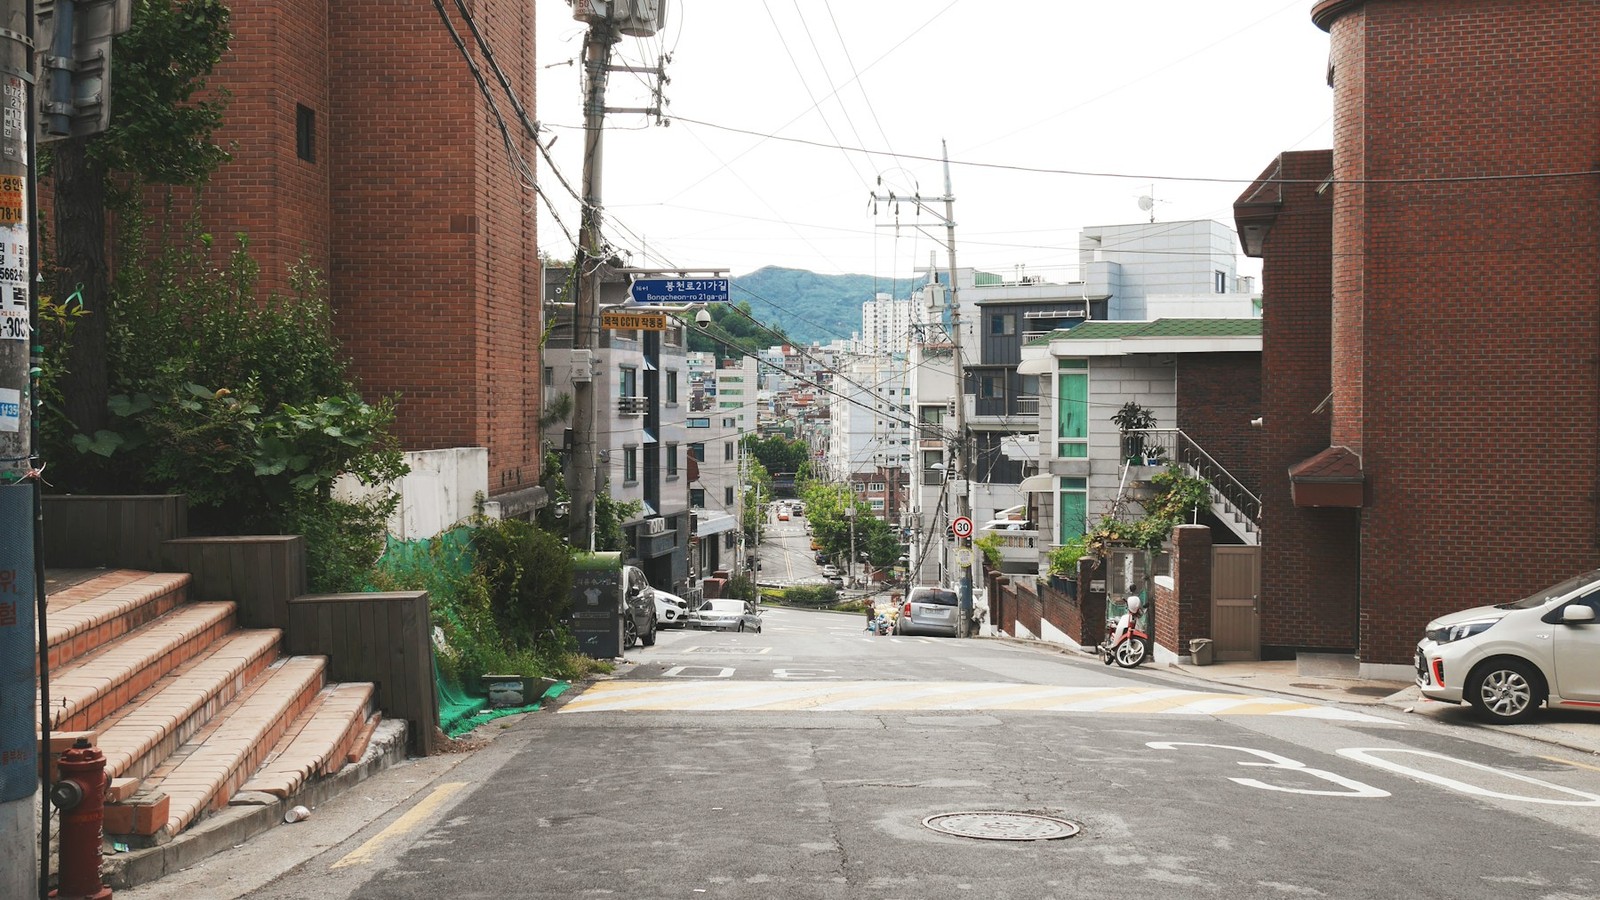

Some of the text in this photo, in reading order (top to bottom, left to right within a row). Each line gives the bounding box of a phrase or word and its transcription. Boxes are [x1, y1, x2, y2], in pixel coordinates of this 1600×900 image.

[665, 281, 727, 292] 봉천로21가길
[646, 293, 727, 302] Bongcheon-ro 21ga-gil
[602, 316, 664, 329] 목적 CCTV 작동중
[957, 522, 969, 532] 30
[1145, 741, 1600, 806] 30
